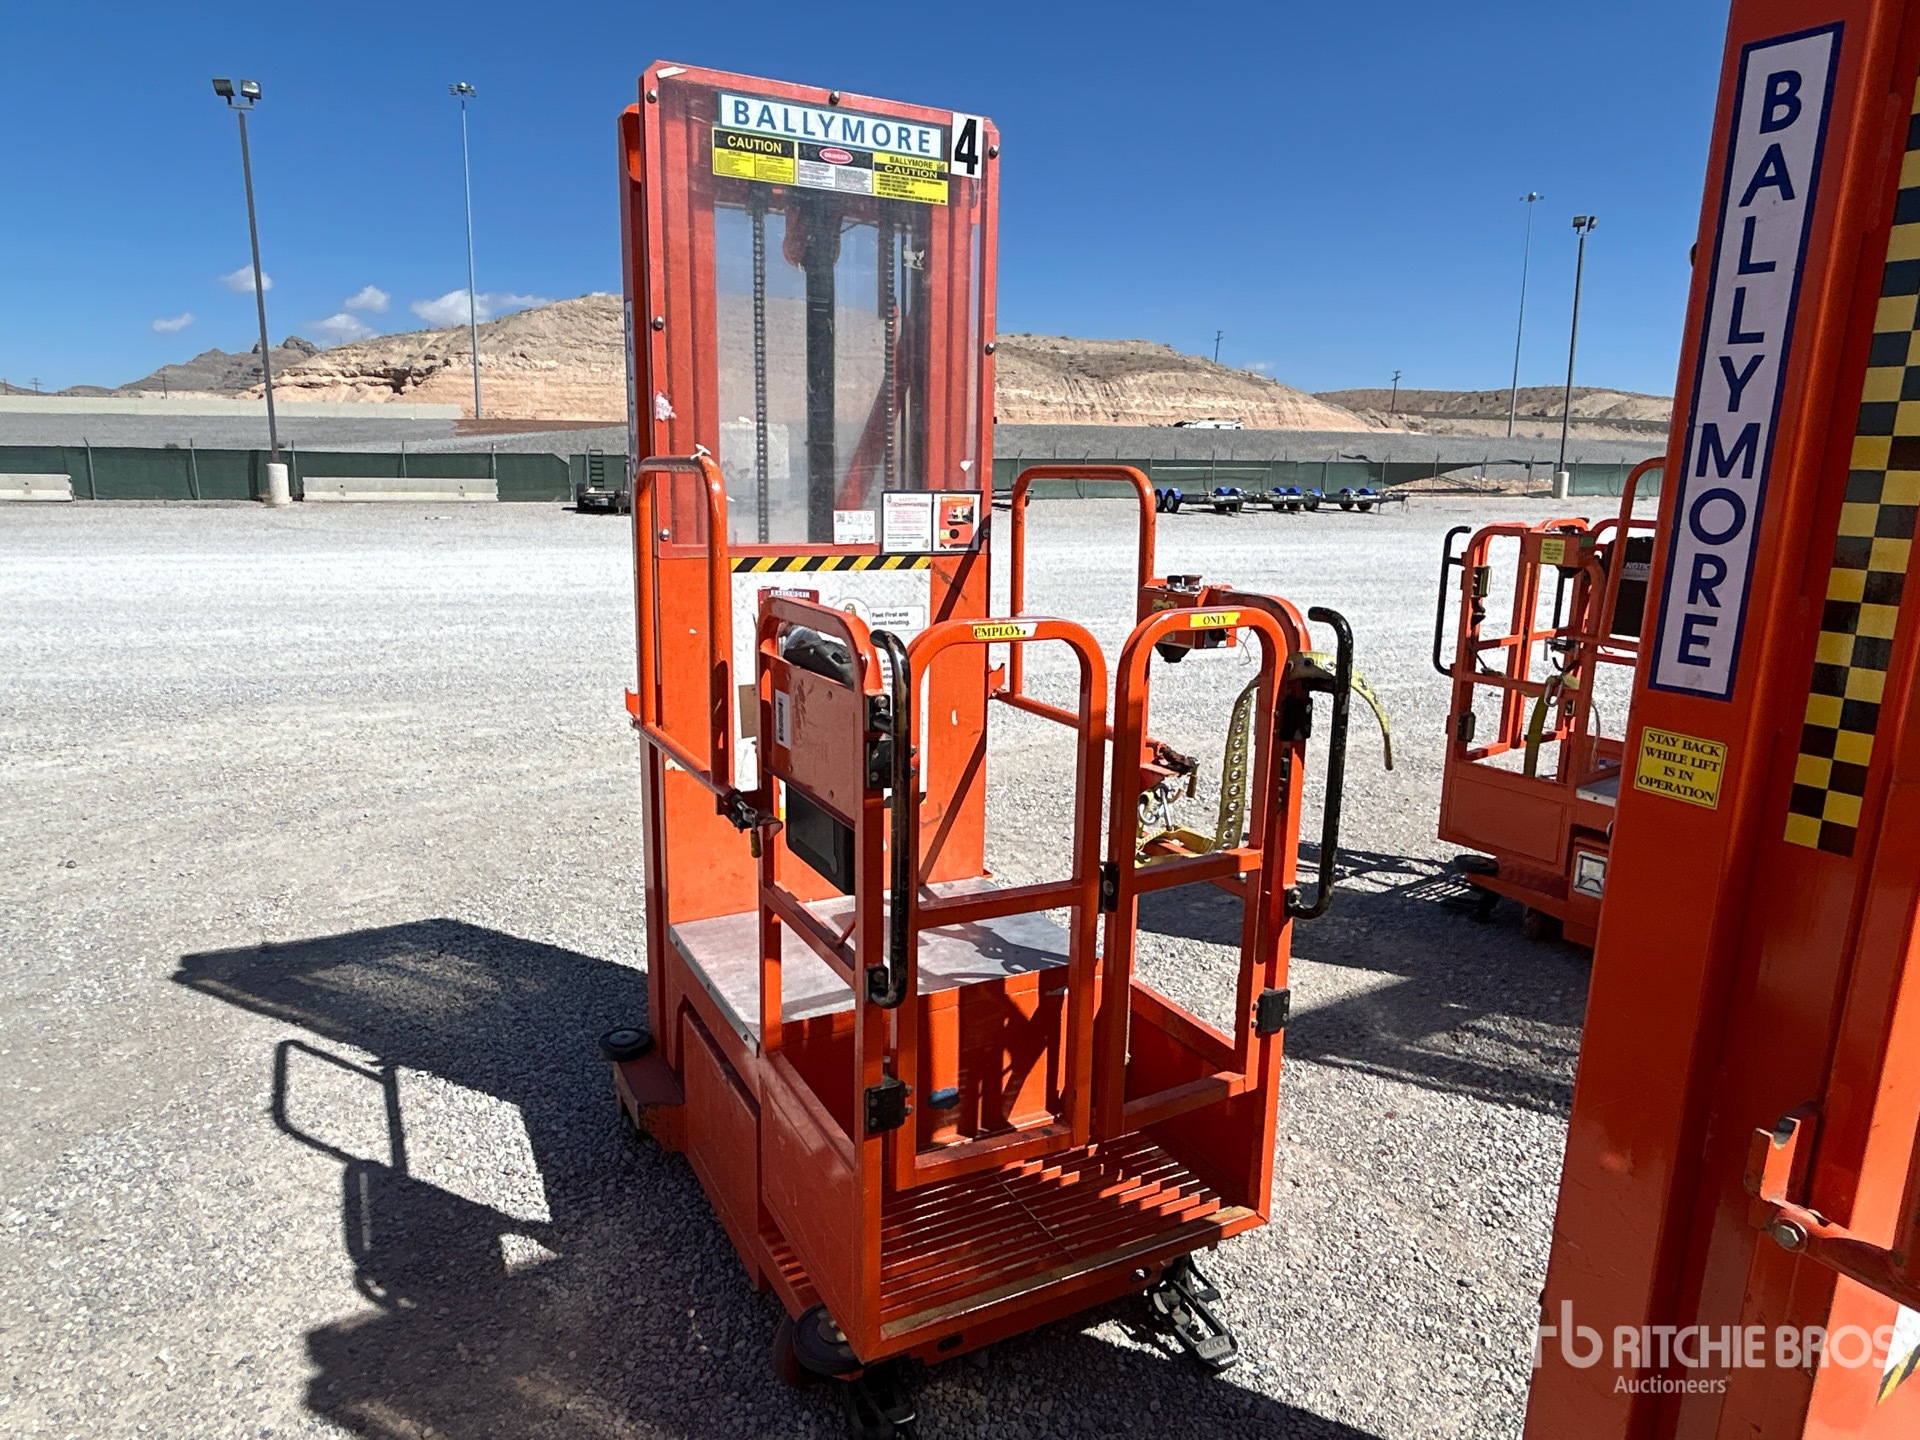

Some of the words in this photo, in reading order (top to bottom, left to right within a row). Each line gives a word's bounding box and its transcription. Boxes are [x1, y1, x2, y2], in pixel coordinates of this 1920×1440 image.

[734, 99, 931, 153] BALLYMORE
[727, 135, 782, 154] CAUTION
[954, 117, 979, 176] 4
[884, 164, 938, 179] CAUTION
[889, 156, 934, 169] BALLYMORE
[1676, 69, 1802, 668] BALLYMORE
[1625, 562, 1651, 570] NOTIC
[1203, 615, 1229, 625] ONLY
[1647, 732, 1680, 747] STAY
[1681, 741, 1720, 758] BACK
[1645, 746, 1688, 765] WHILE
[1690, 757, 1720, 773] LIFT
[1663, 766, 1676, 777] IS
[1678, 769, 1694, 782] IN
[1638, 775, 1715, 803] OPERATION
